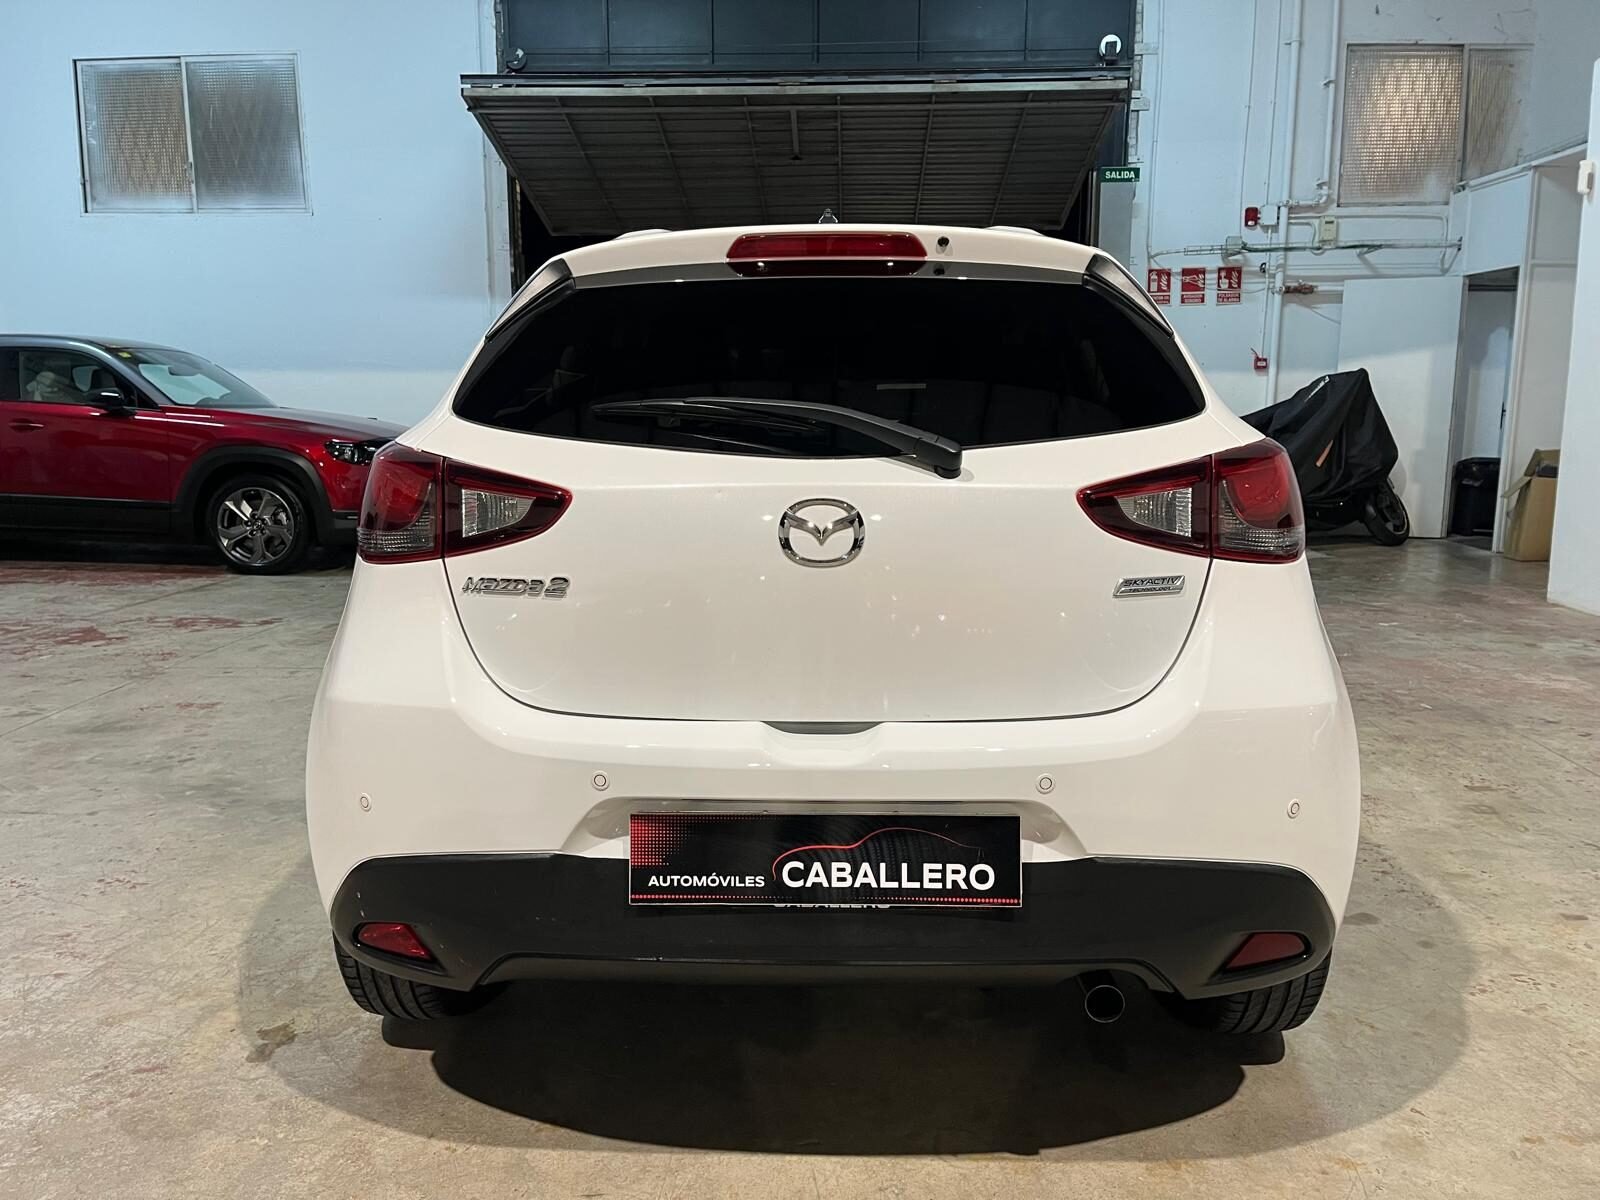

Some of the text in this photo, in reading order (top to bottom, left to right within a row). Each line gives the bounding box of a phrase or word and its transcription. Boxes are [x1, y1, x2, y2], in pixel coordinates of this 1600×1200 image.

[1105, 171, 1135, 179] SALIDA
[1123, 577, 1180, 587] SKYACTIV
[648, 861, 996, 891] AUTOMÓVILES CABALLERO
